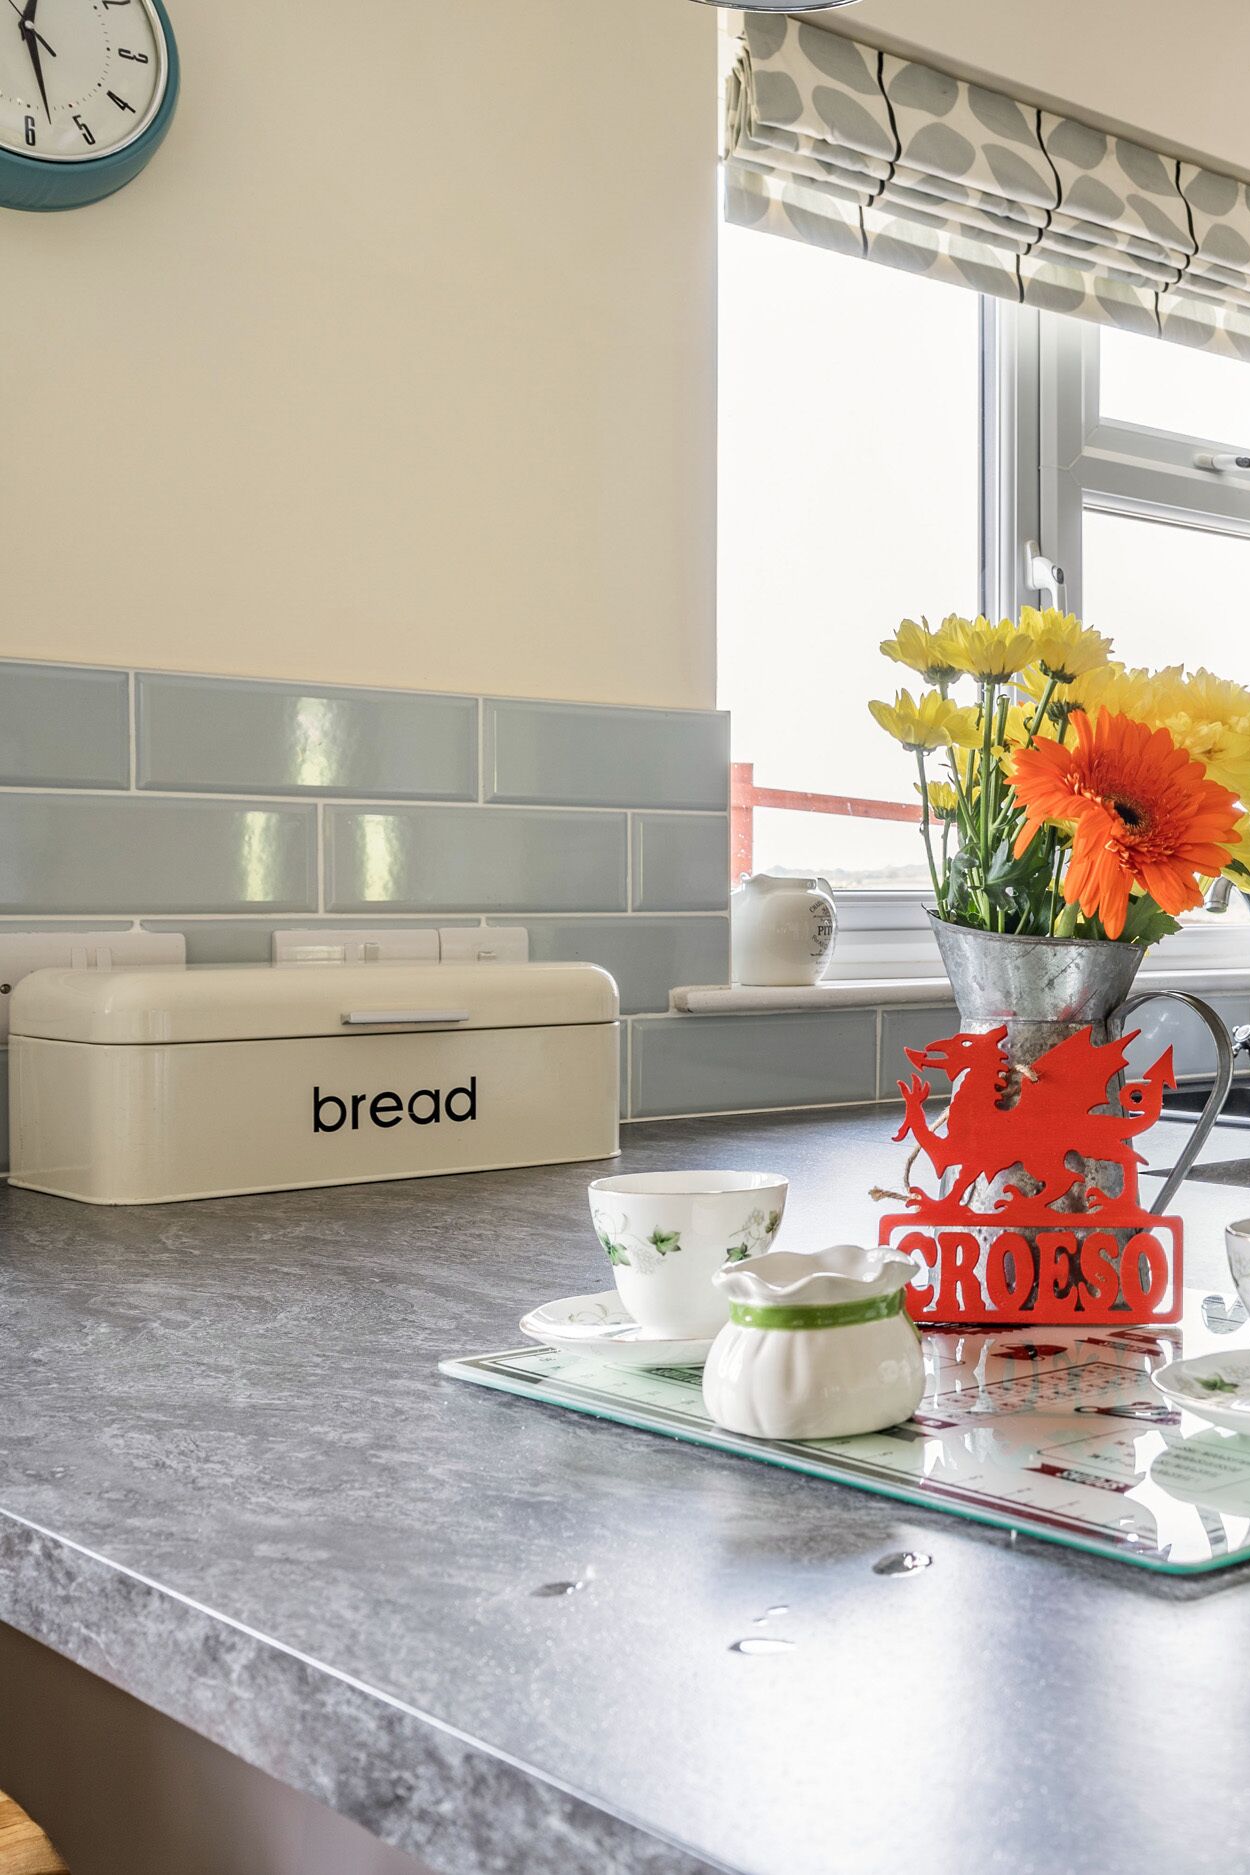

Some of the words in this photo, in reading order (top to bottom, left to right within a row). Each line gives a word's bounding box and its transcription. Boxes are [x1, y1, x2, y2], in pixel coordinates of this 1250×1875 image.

[118, 47, 149, 64] 3
[106, 90, 136, 114] 4
[24, 115, 36, 146] 6
[72, 114, 96, 145] 5
[313, 1076, 477, 1133] bread
[896, 1231, 1169, 1312] CROESO
